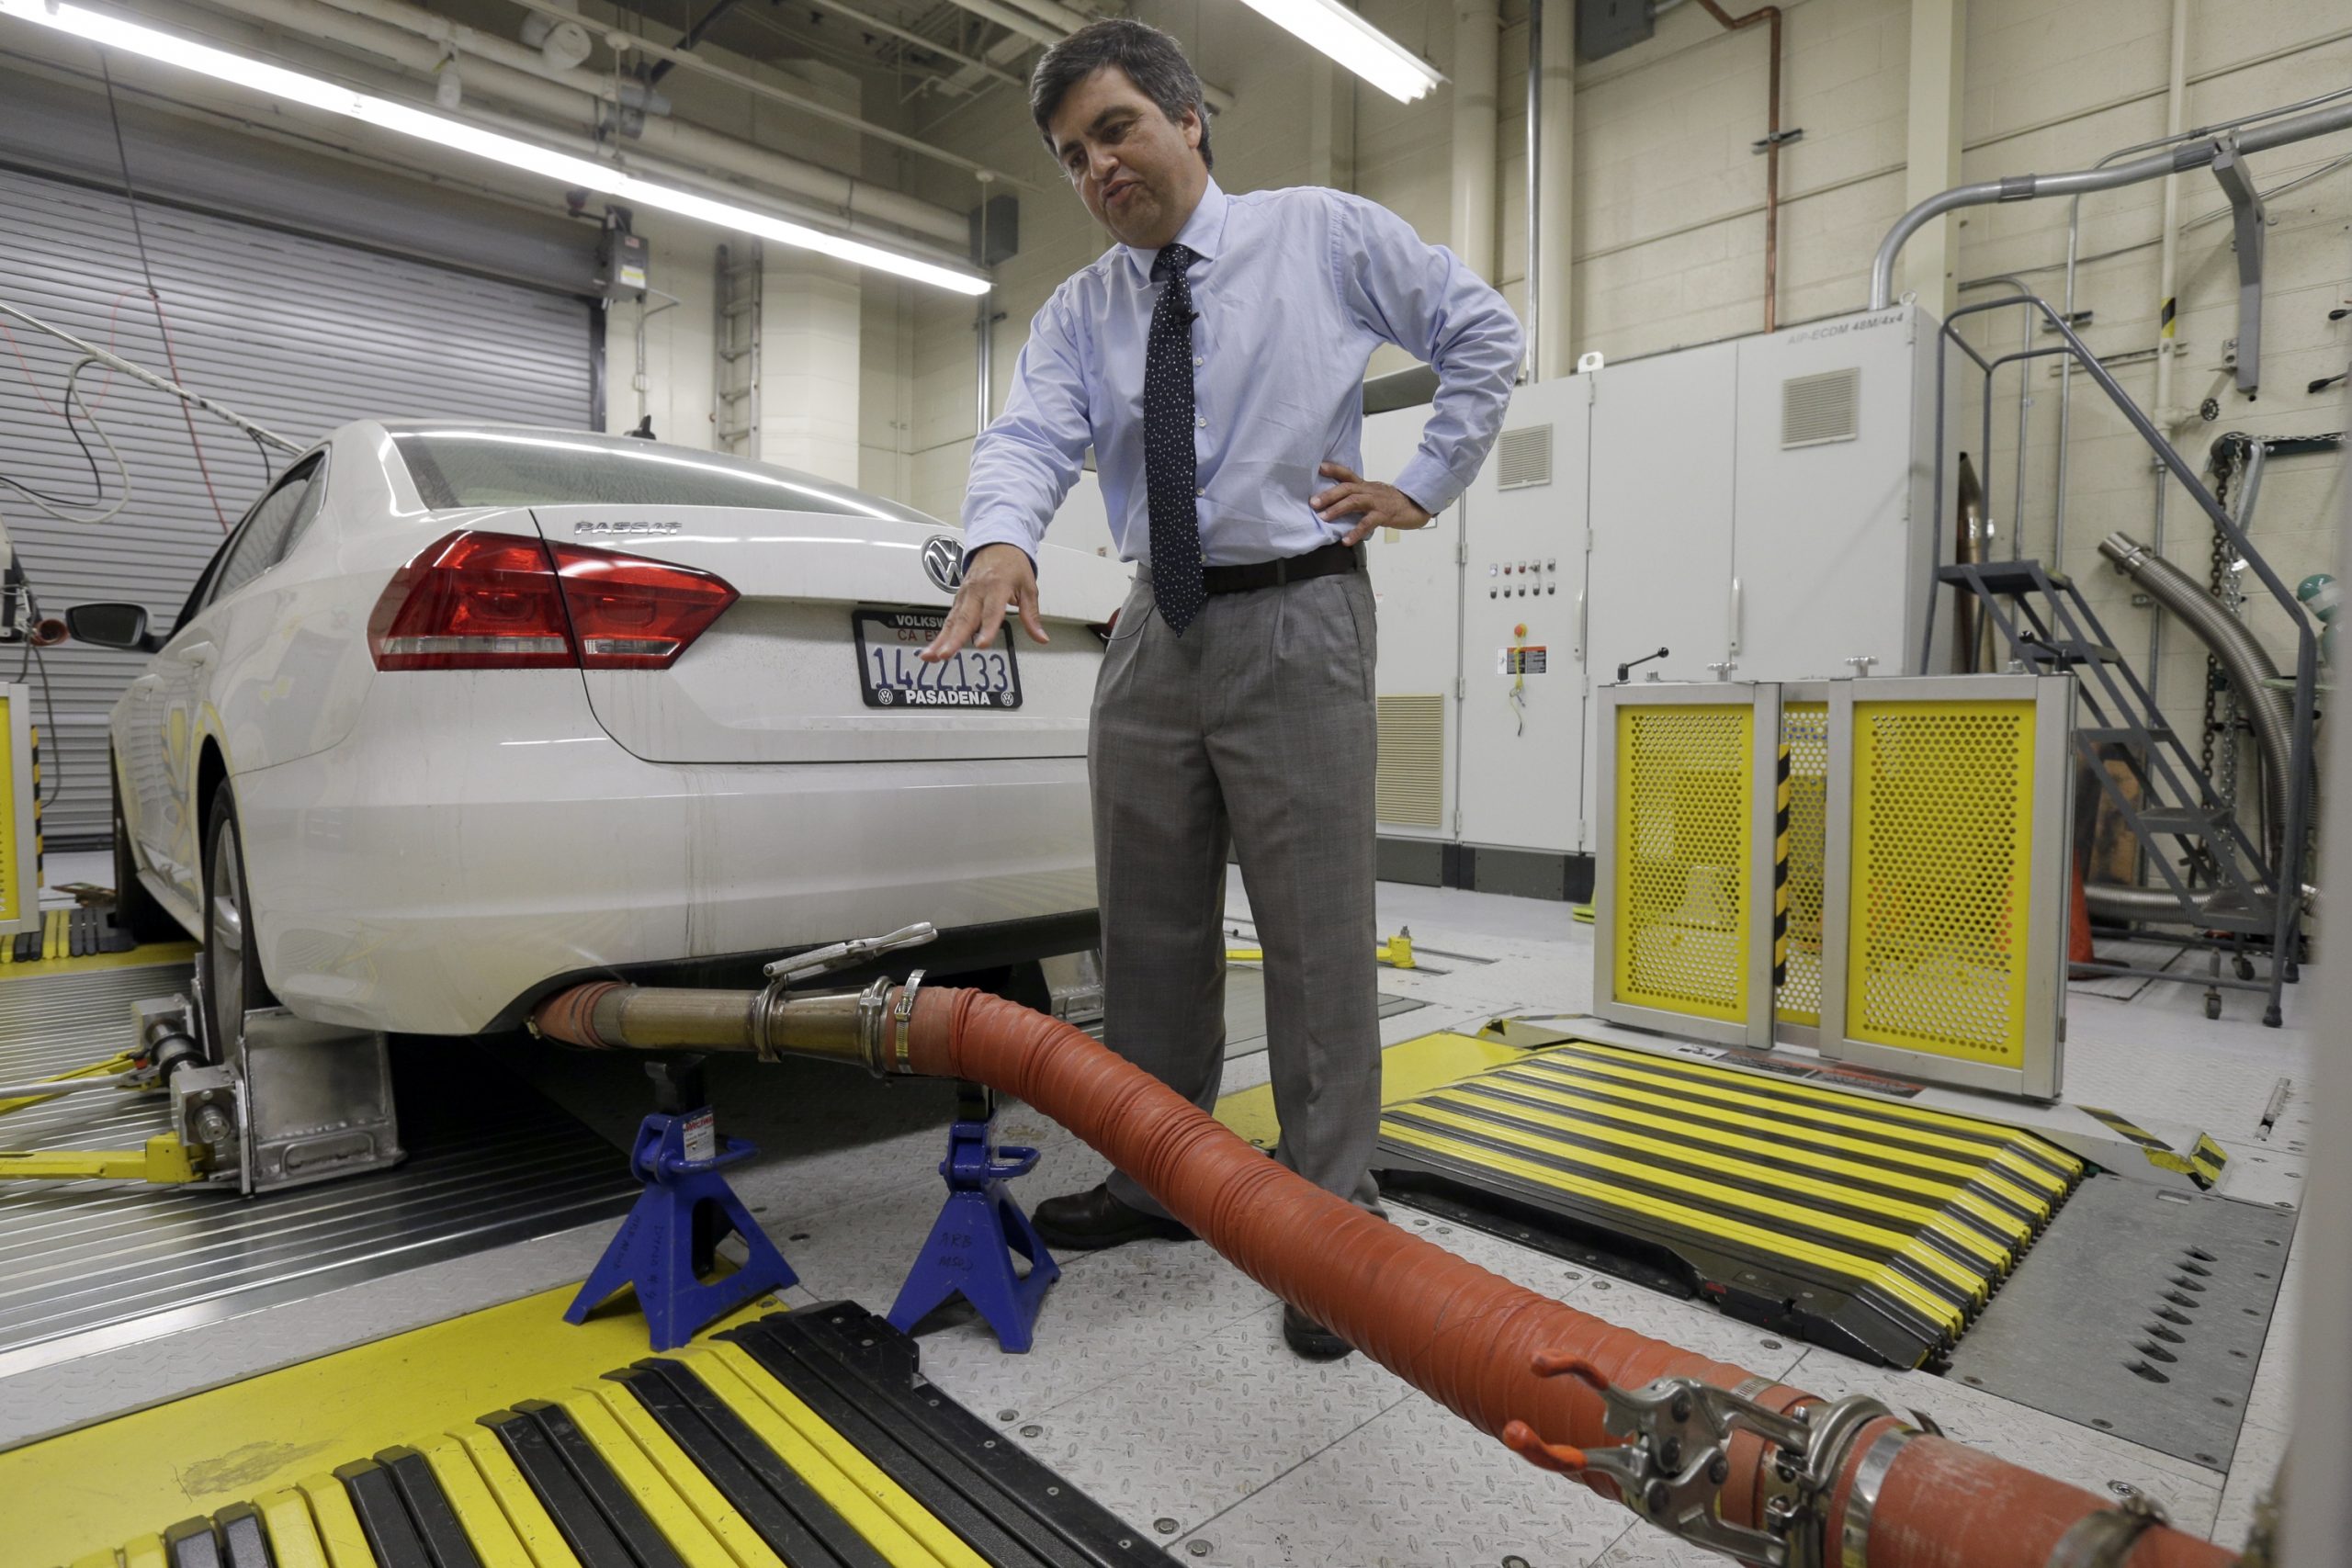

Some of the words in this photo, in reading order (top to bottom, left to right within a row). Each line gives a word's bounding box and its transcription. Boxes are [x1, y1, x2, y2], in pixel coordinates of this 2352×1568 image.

[574, 521, 683, 536] PASSAT
[896, 615, 947, 628] VOLKSW
[897, 629, 918, 641] CA
[905, 689, 991, 705] PASADENA
